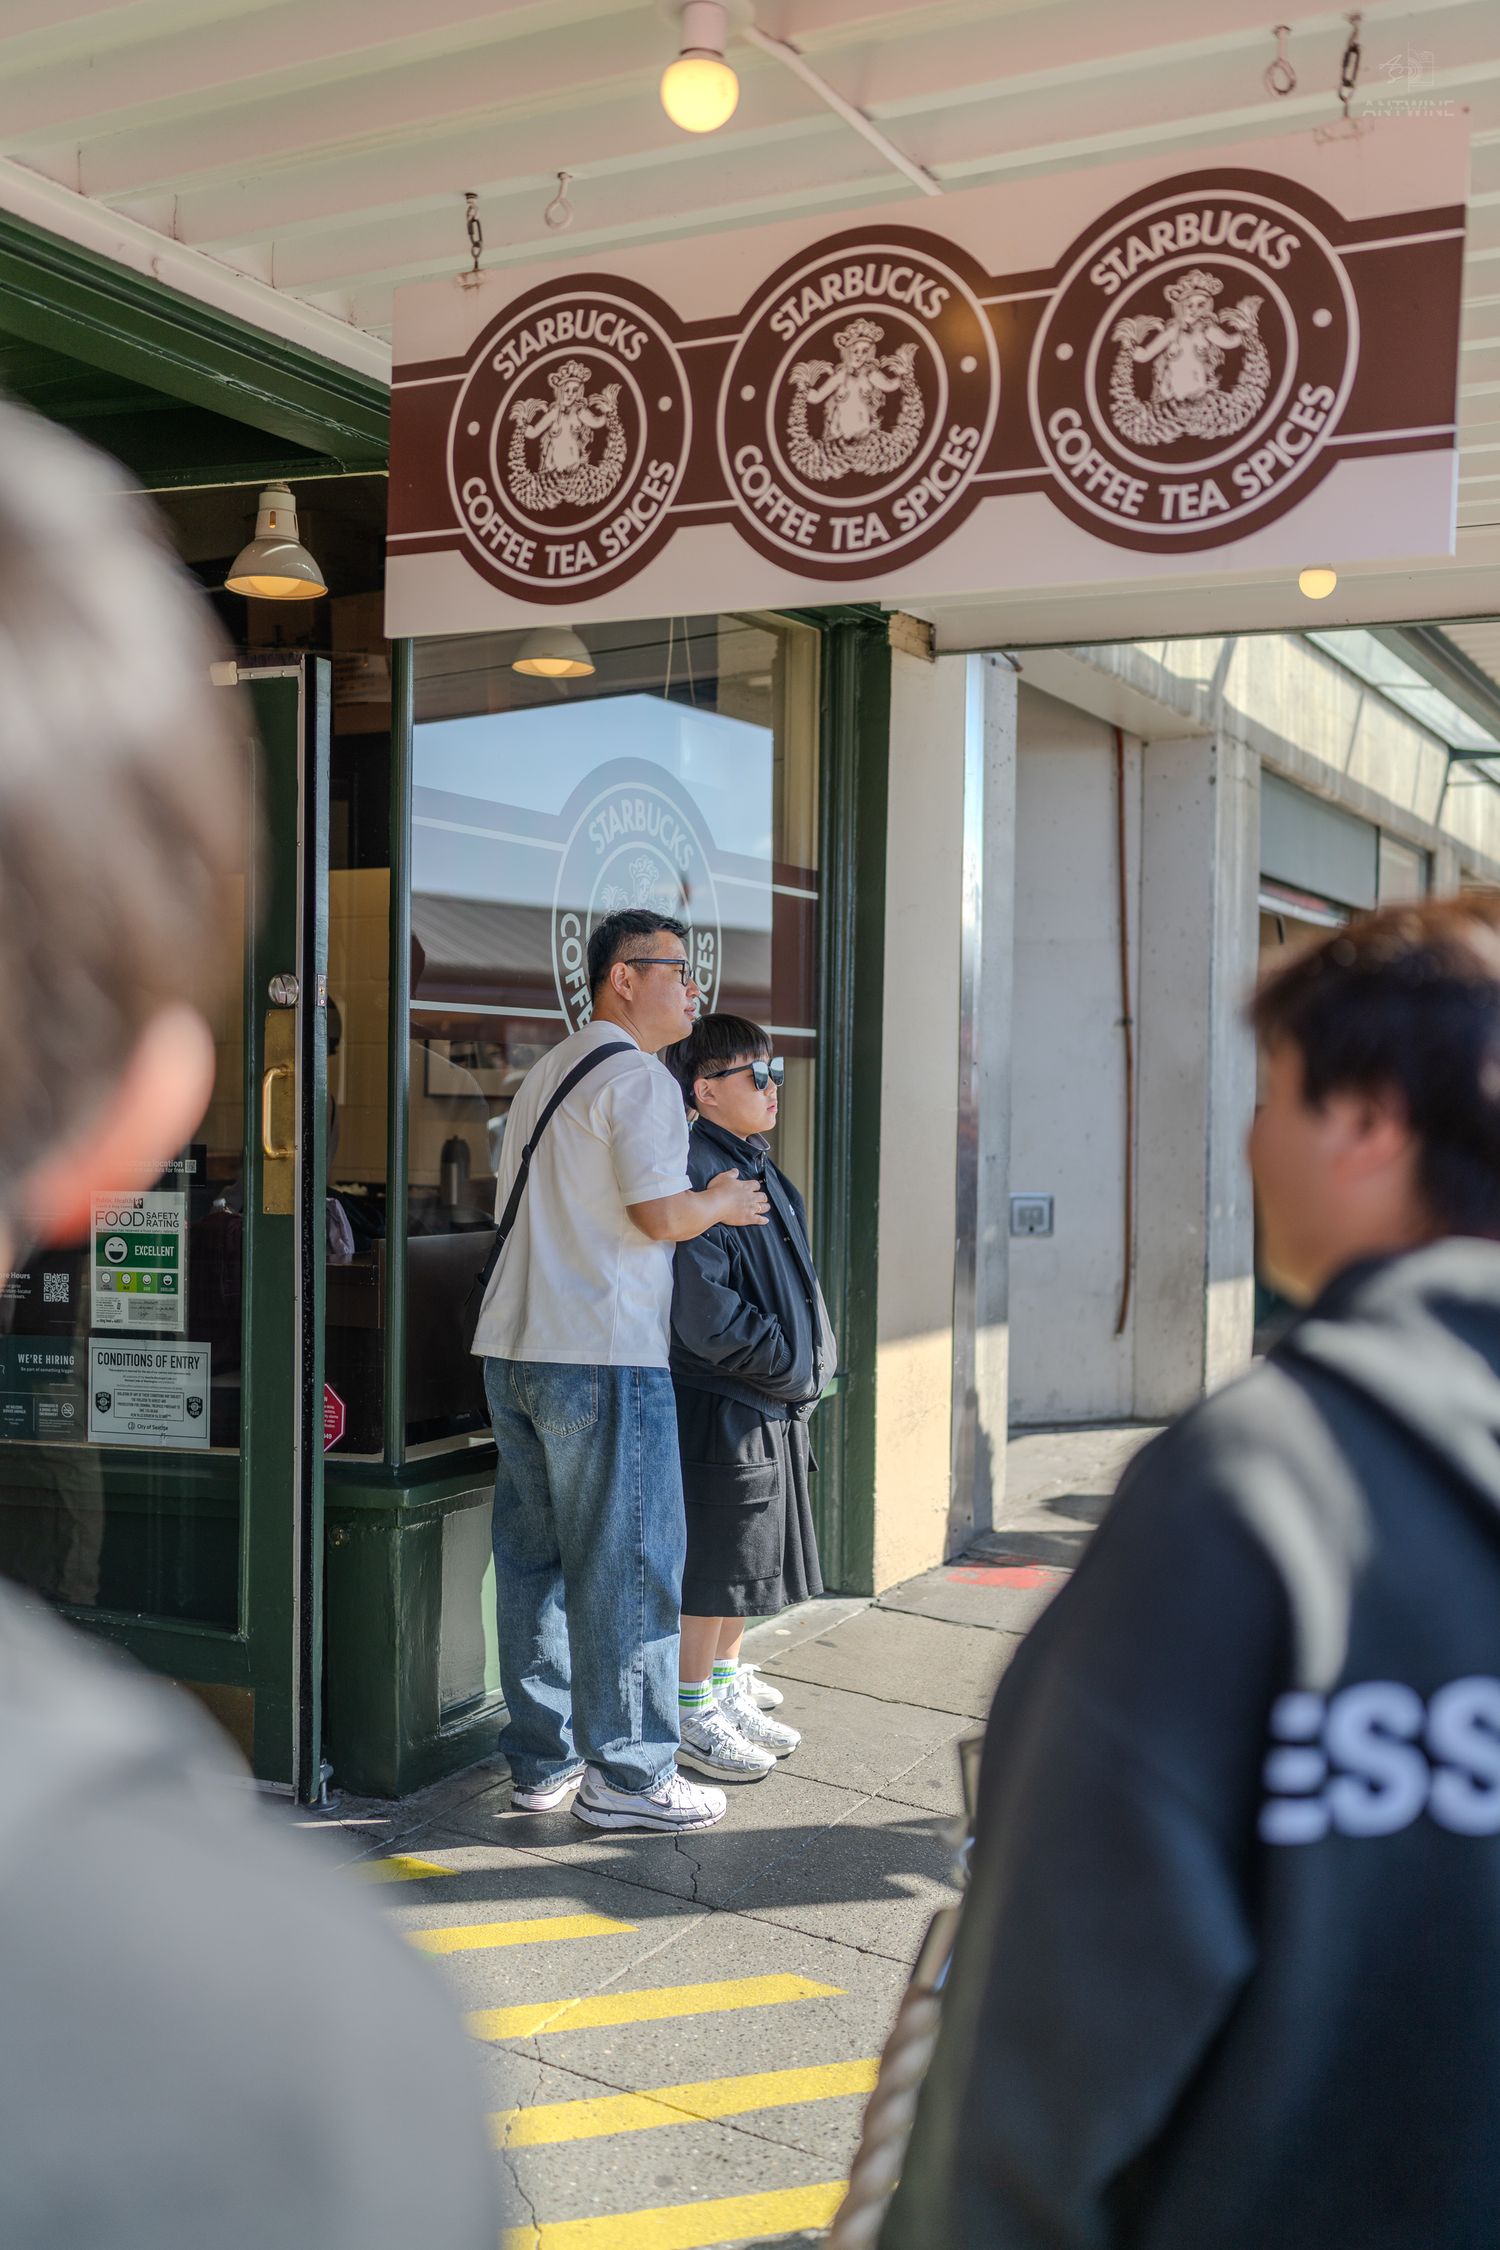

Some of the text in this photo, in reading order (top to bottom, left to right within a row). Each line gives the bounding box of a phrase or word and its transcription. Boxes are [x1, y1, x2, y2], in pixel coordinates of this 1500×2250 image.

[1090, 209, 1301, 295] STARBUCKS
[769, 263, 950, 341] STARBUCKS
[492, 309, 648, 380] STARBUCKS
[733, 423, 980, 551] COFFEE TEA SPICES
[1048, 383, 1335, 521] COFFEE TEA SPICES
[461, 458, 675, 576] COFFEE TEA SPICES
[588, 798, 694, 871] STARBUCKS
[560, 912, 593, 1030] COFFE
[96, 1211, 179, 1227] FOOD SAFETY
[134, 1245, 174, 1257] EXCELLENT
[146, 1219, 180, 1228] RATING
[18, 1353, 75, 1366] WE'RE HIRING
[97, 1352, 200, 1370] CONDITIONS OF ENTRY
